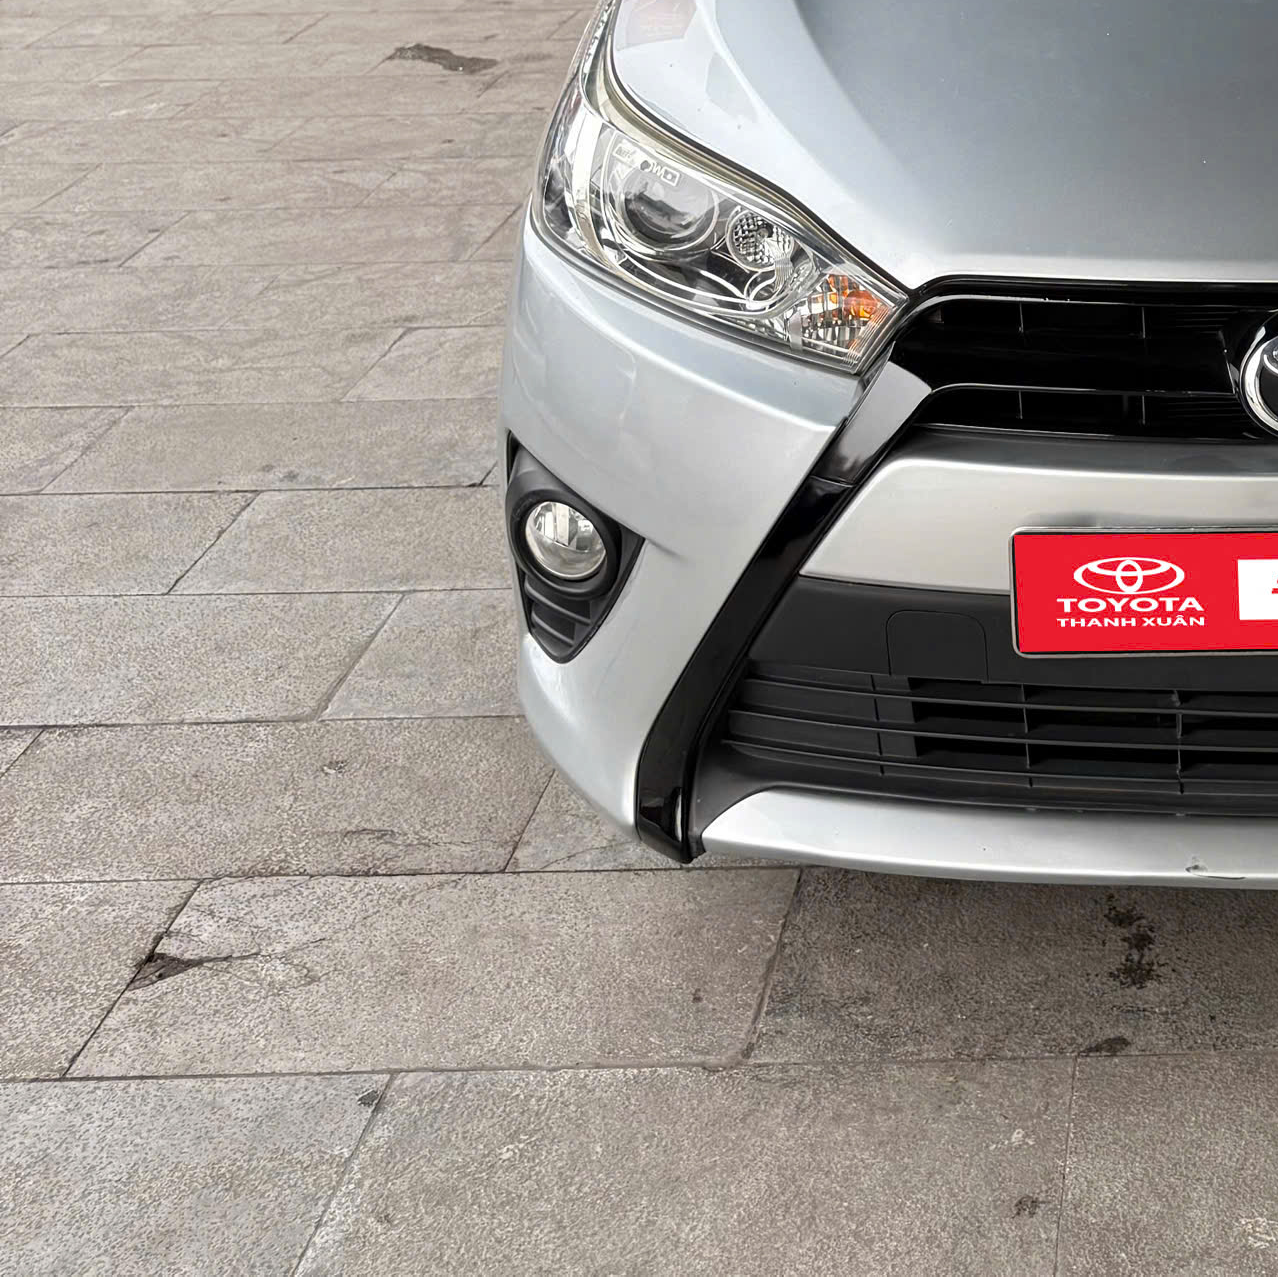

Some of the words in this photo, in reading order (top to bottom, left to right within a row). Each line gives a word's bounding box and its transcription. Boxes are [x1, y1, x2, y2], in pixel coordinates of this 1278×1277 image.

[1056, 597, 1204, 612] TOYOTA
[1056, 617, 1137, 627] THANH
[1142, 614, 1205, 627] XUÂN
